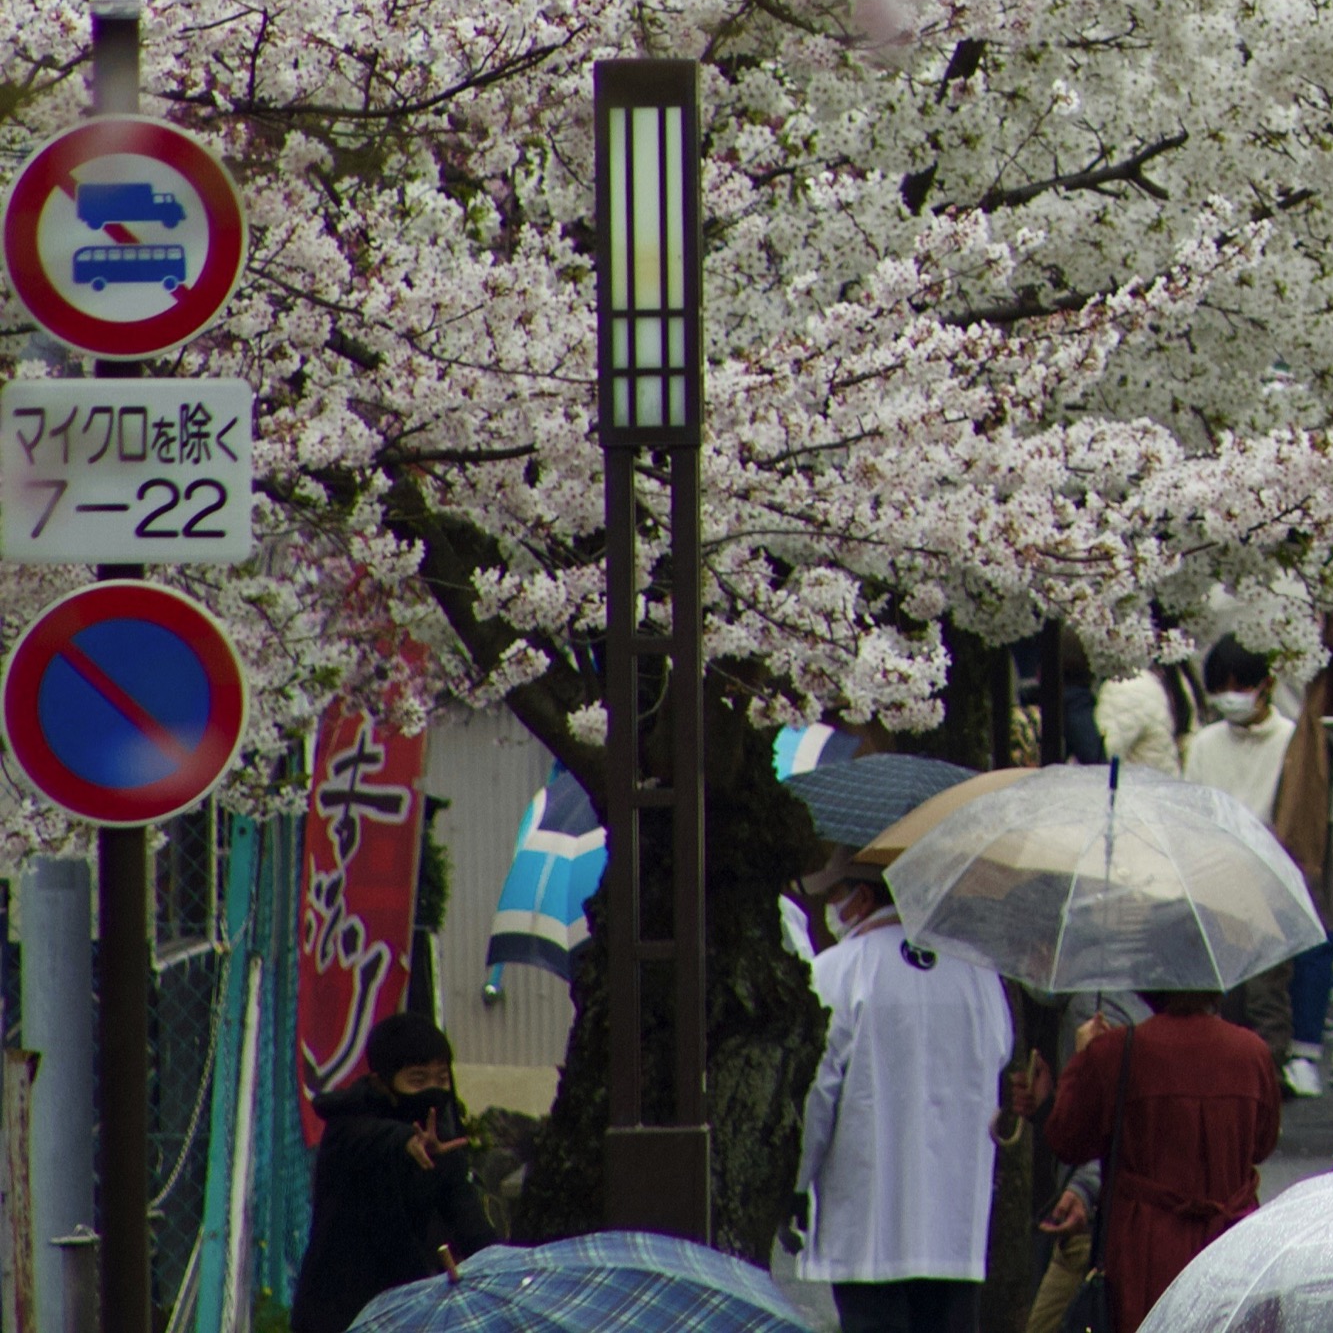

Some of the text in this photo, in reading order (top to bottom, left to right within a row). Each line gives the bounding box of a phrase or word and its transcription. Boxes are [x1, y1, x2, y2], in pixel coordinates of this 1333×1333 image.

[13, 401, 239, 465] マイクロを除く
